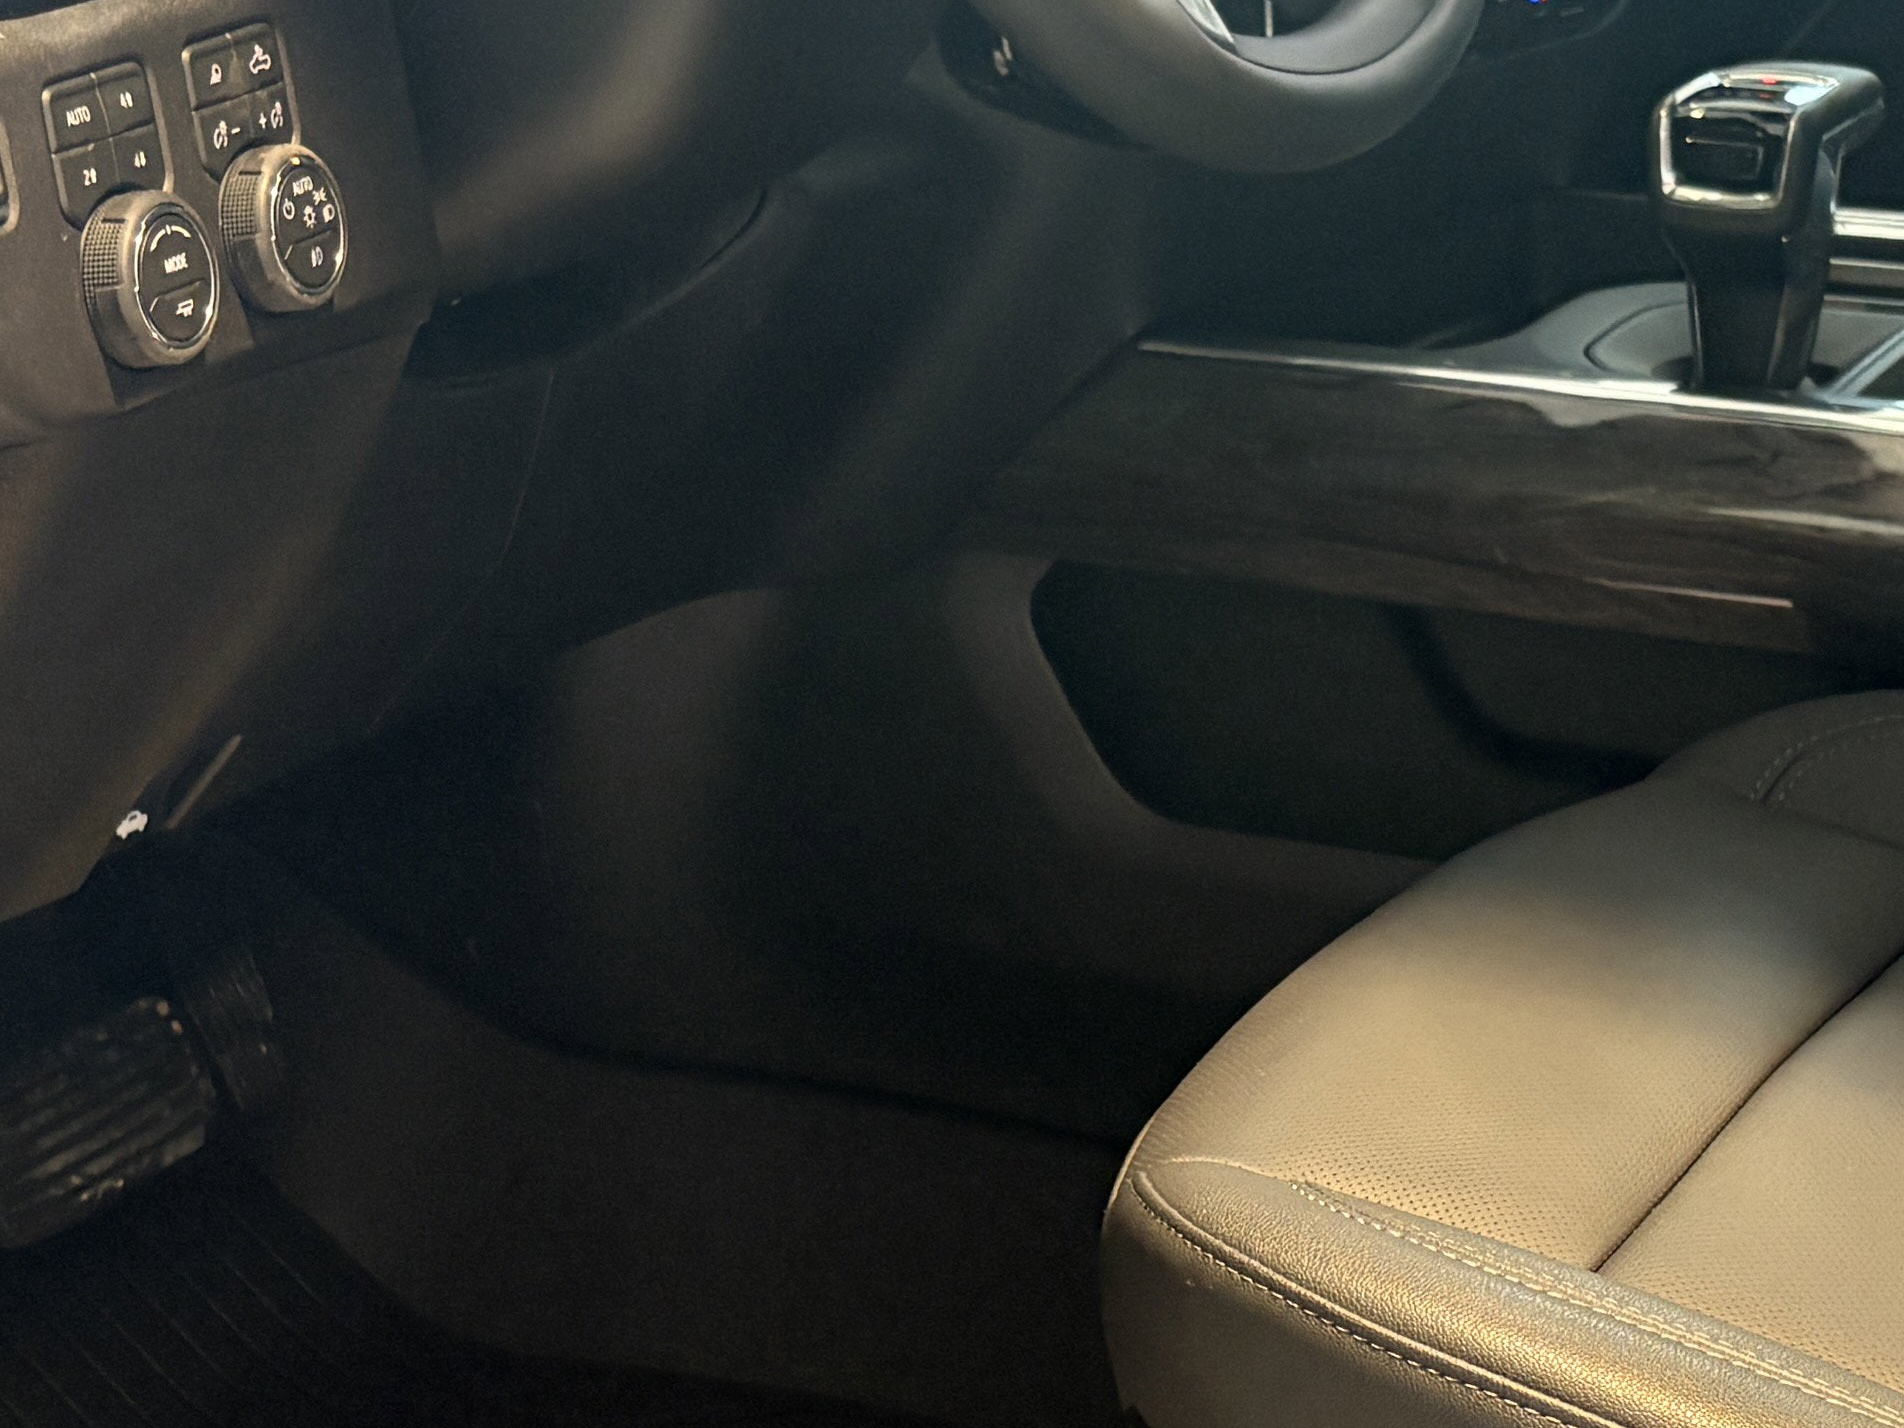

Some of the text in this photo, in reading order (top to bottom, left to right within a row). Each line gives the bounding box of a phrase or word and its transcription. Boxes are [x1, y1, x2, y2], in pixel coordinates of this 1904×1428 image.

[66, 105, 92, 128] AUTO
[292, 175, 314, 197] AUTO
[164, 251, 189, 274] MODE
